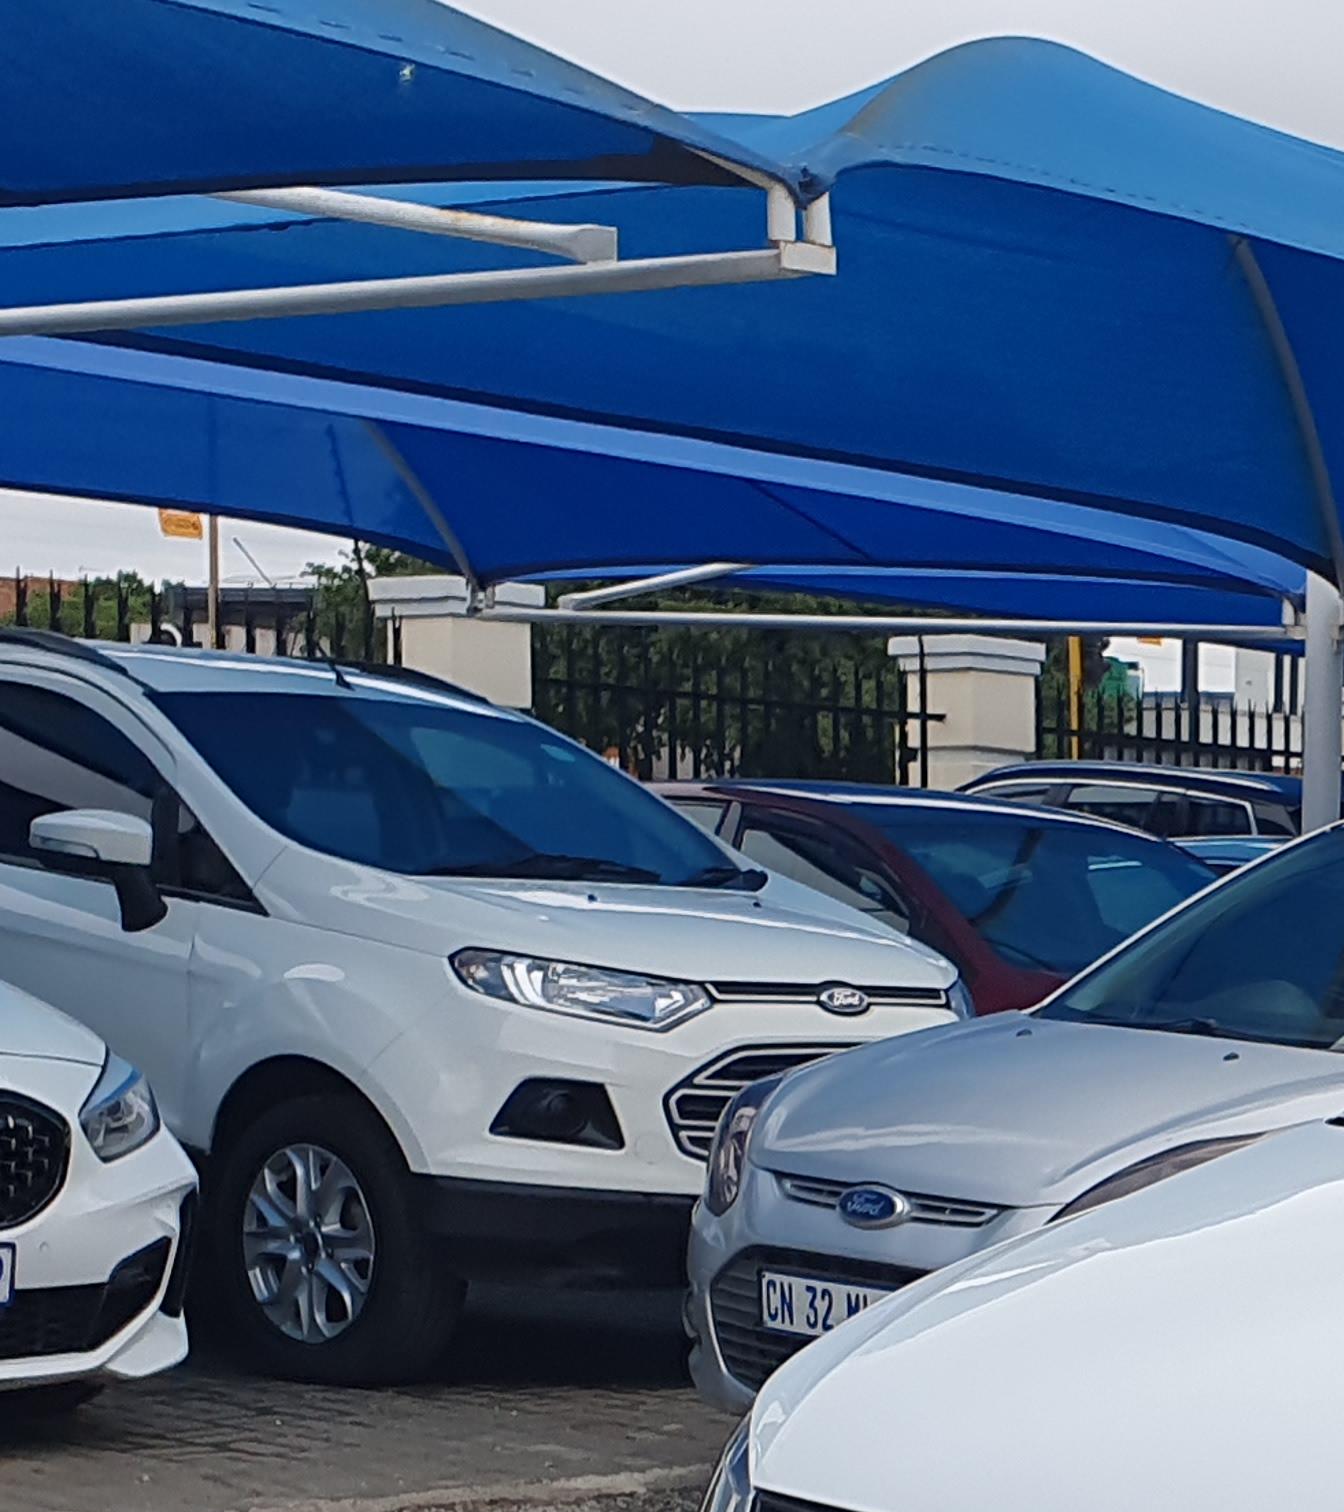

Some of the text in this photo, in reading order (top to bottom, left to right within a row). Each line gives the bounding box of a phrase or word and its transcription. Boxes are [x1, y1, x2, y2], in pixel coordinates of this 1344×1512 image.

[846, 1191, 887, 1216] Ford
[766, 1279, 794, 1326] CN
[805, 1285, 834, 1332] 32
